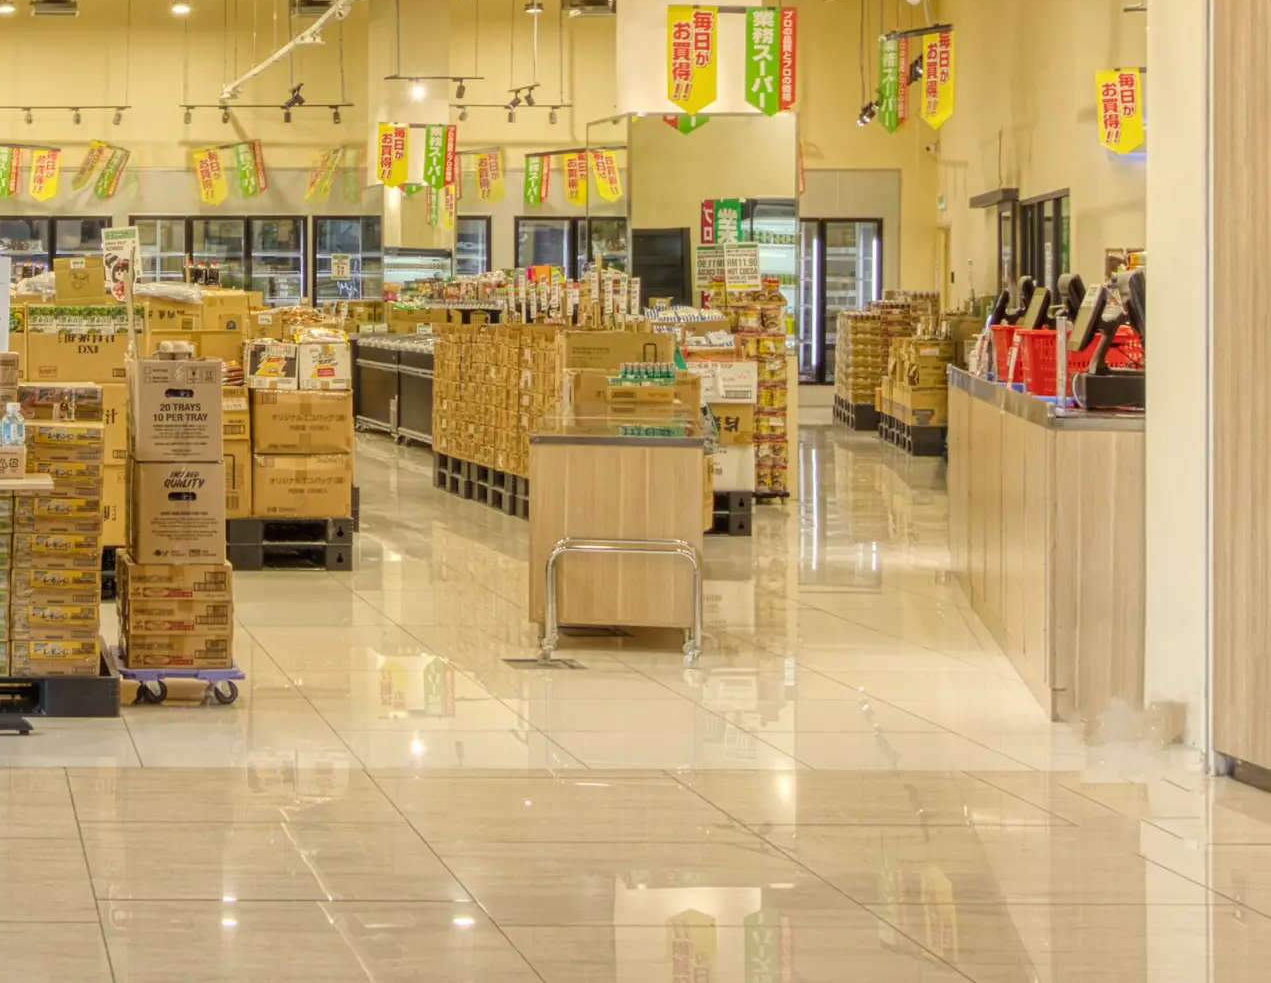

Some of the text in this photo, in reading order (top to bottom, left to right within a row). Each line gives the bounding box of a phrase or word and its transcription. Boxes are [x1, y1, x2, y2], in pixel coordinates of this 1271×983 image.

[692, 11, 714, 67] 毎日が
[751, 10, 775, 109] 業務スーパー
[1117, 73, 1137, 118] 毎日が
[153, 414, 209, 422] 10 PER TRAY
[160, 403, 201, 411] 20 TRAYS
